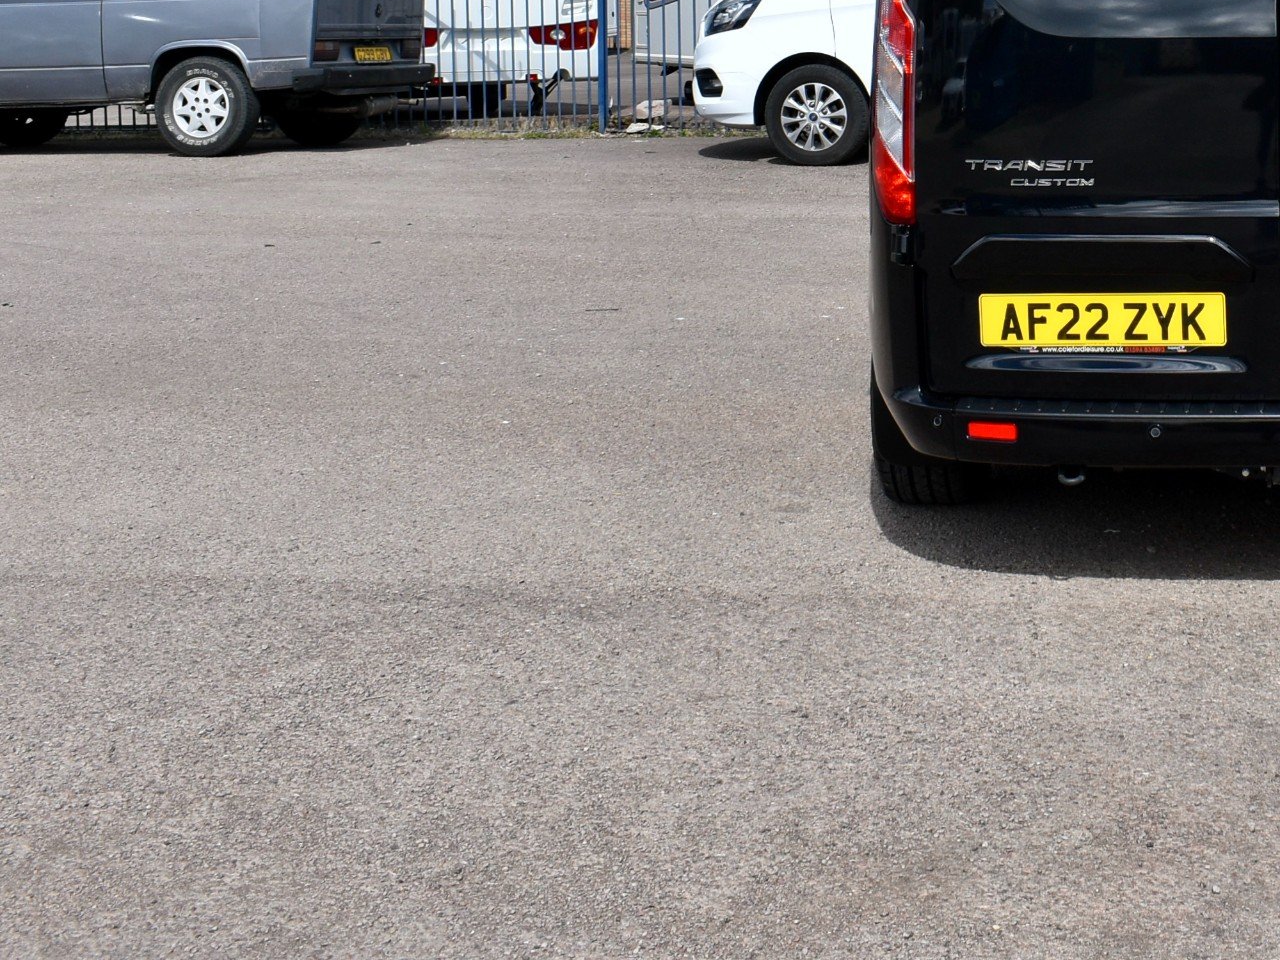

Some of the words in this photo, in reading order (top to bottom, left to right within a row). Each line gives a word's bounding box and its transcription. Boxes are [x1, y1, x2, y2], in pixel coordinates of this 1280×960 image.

[964, 159, 1095, 172] TRANSIT
[1010, 177, 1095, 187] CUSTOM
[1000, 302, 1110, 341] AF22
[1123, 302, 1207, 341] ZYK
